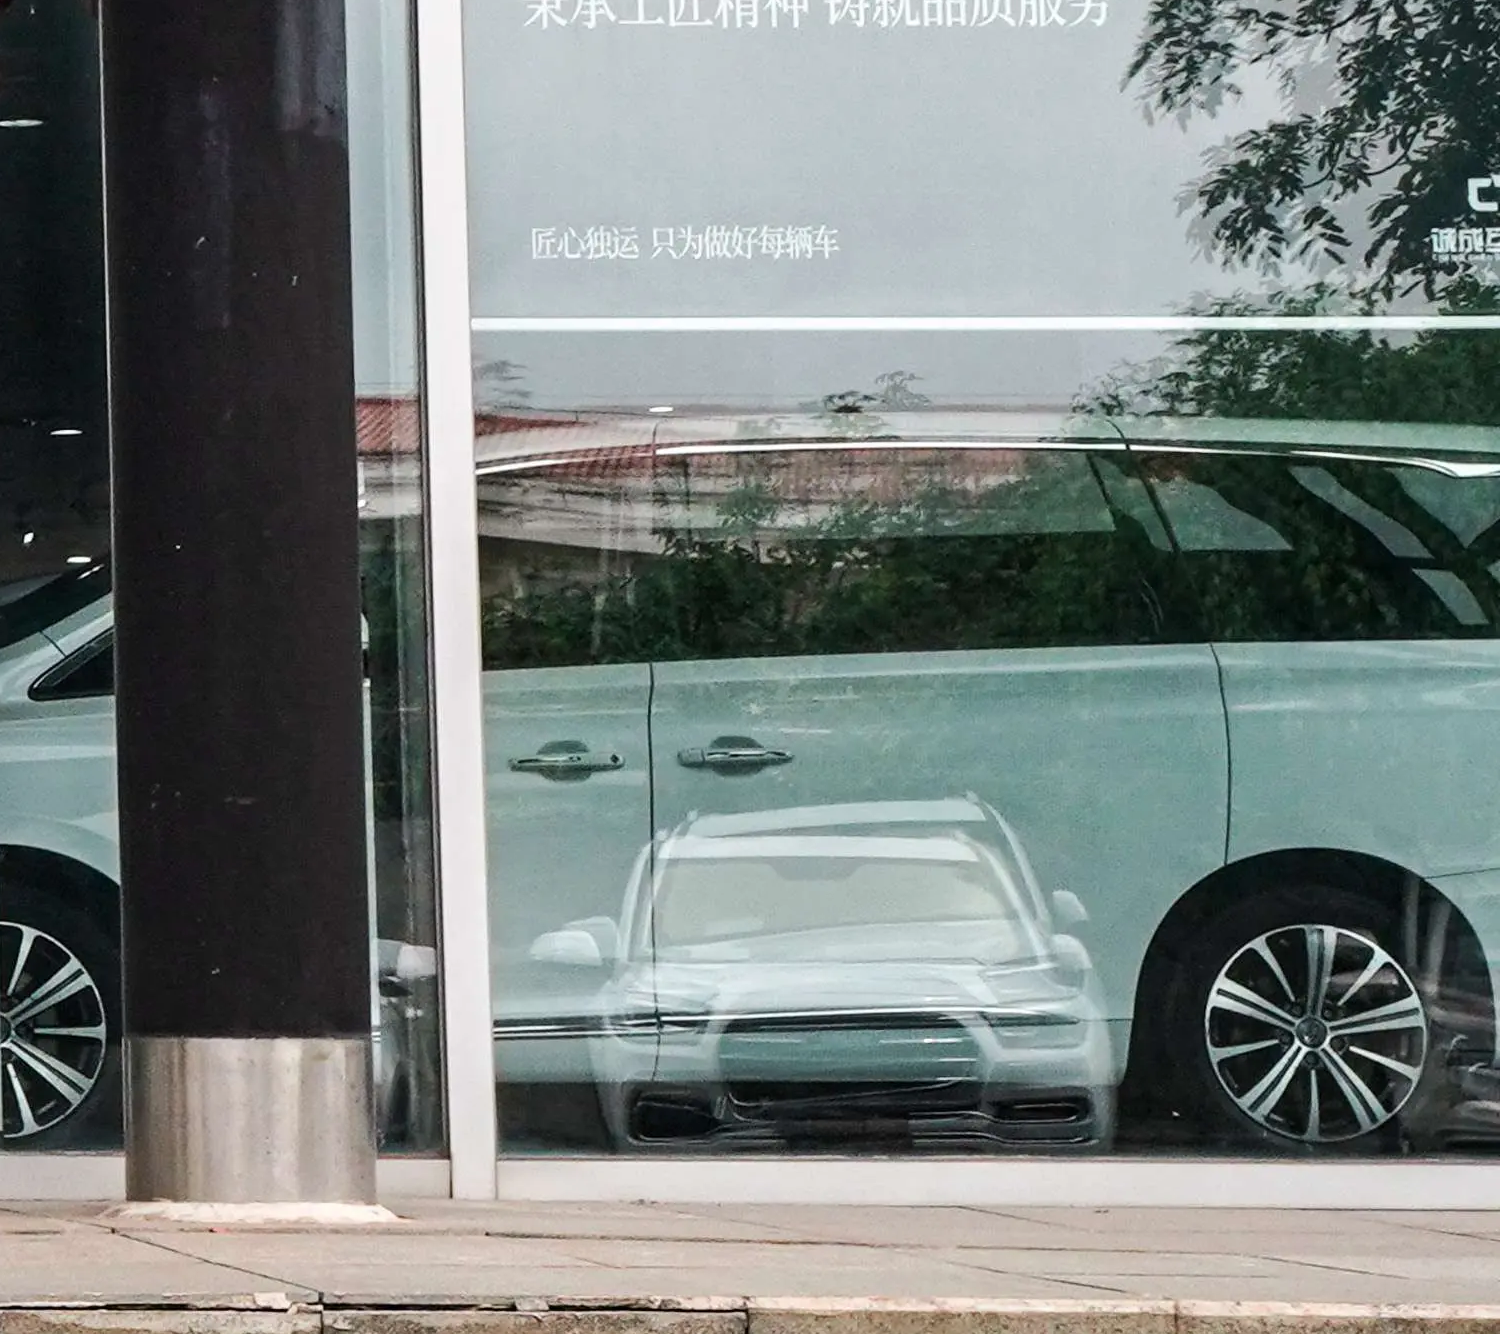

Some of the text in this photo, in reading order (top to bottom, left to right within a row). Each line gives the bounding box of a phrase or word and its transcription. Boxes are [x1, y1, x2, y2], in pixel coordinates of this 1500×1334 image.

[531, 224, 841, 260] 匠心独运 只为做好每辆车
